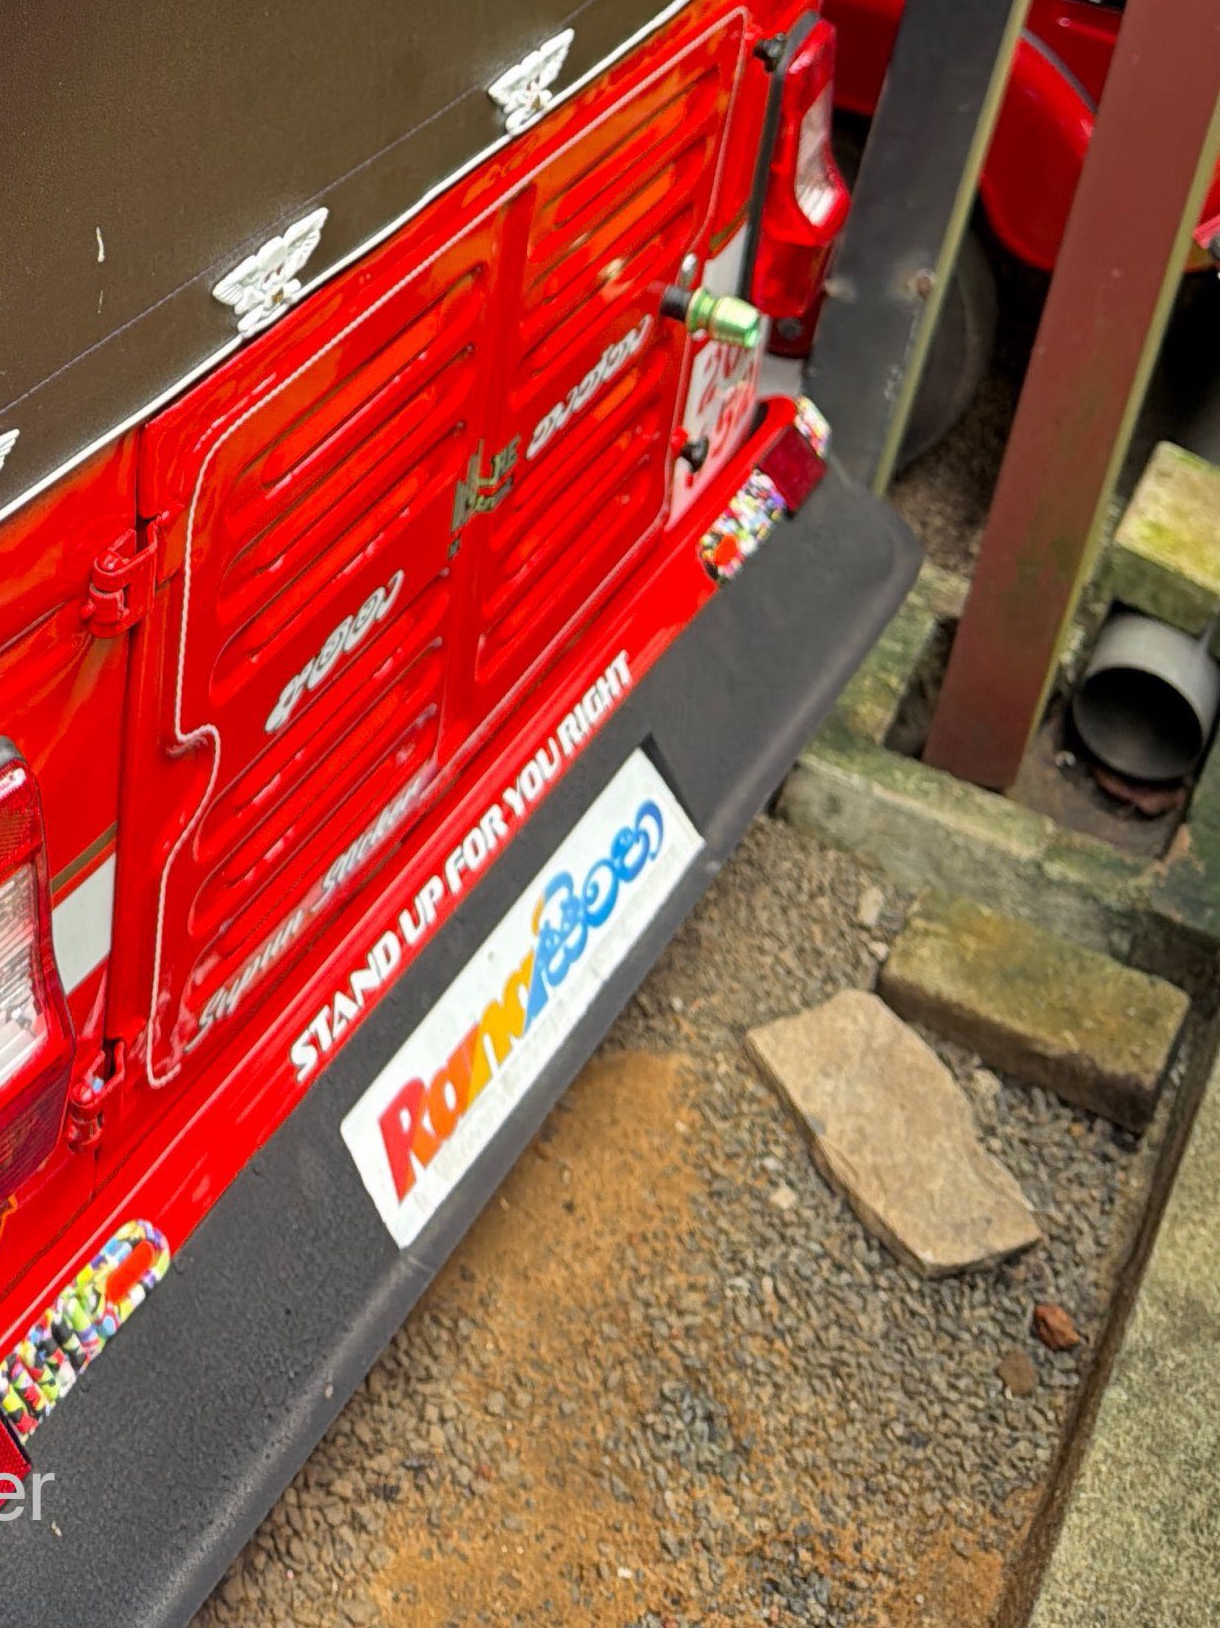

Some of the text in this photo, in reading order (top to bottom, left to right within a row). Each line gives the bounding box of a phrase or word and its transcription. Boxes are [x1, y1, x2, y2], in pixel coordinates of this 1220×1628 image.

[289, 649, 632, 1082] STAND UP FOR YOU RIGHT
